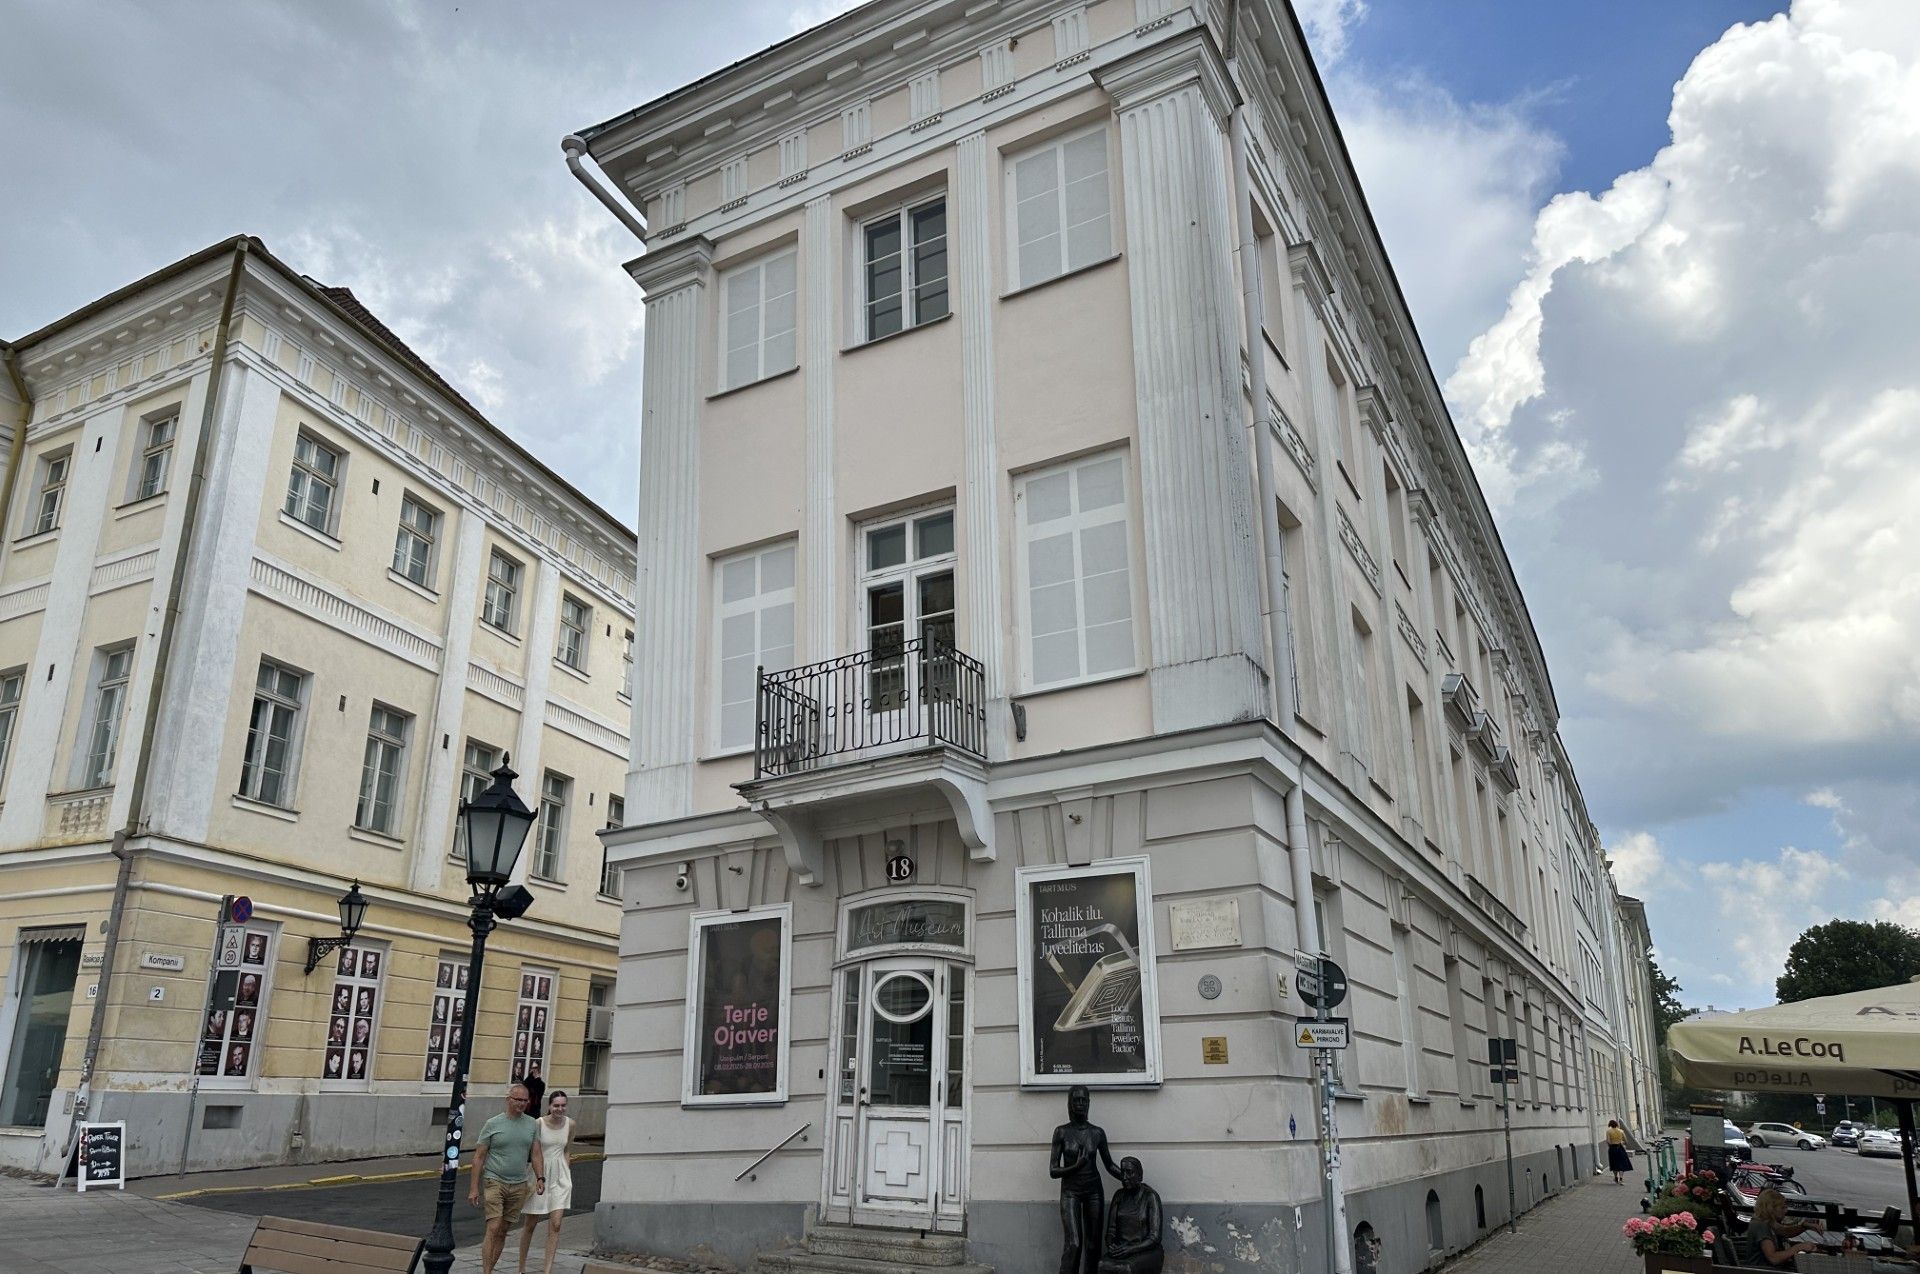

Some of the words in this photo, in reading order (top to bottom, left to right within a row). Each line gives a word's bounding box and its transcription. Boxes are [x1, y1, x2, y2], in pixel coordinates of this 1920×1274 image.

[889, 858, 911, 878] 18
[1040, 907, 1084, 922] Kohalik
[1086, 905, 1104, 920] ilu.
[857, 909, 888, 942] Art
[894, 905, 966, 937] Museum
[1040, 924, 1087, 939] Tallinna
[1040, 939, 1105, 959] Juveelitehas
[89, 986, 97, 995] 16
[154, 988, 161, 999] 2
[724, 1002, 768, 1027] Terje
[1111, 1003, 1129, 1013] Local
[1111, 1024, 1136, 1033] Tallinn
[714, 1026, 777, 1050] Ojaver
[1111, 1034, 1140, 1045] Jewellery
[1111, 1045, 1137, 1055] Factory
[1738, 1037, 1844, 1062] A.LeCoq
